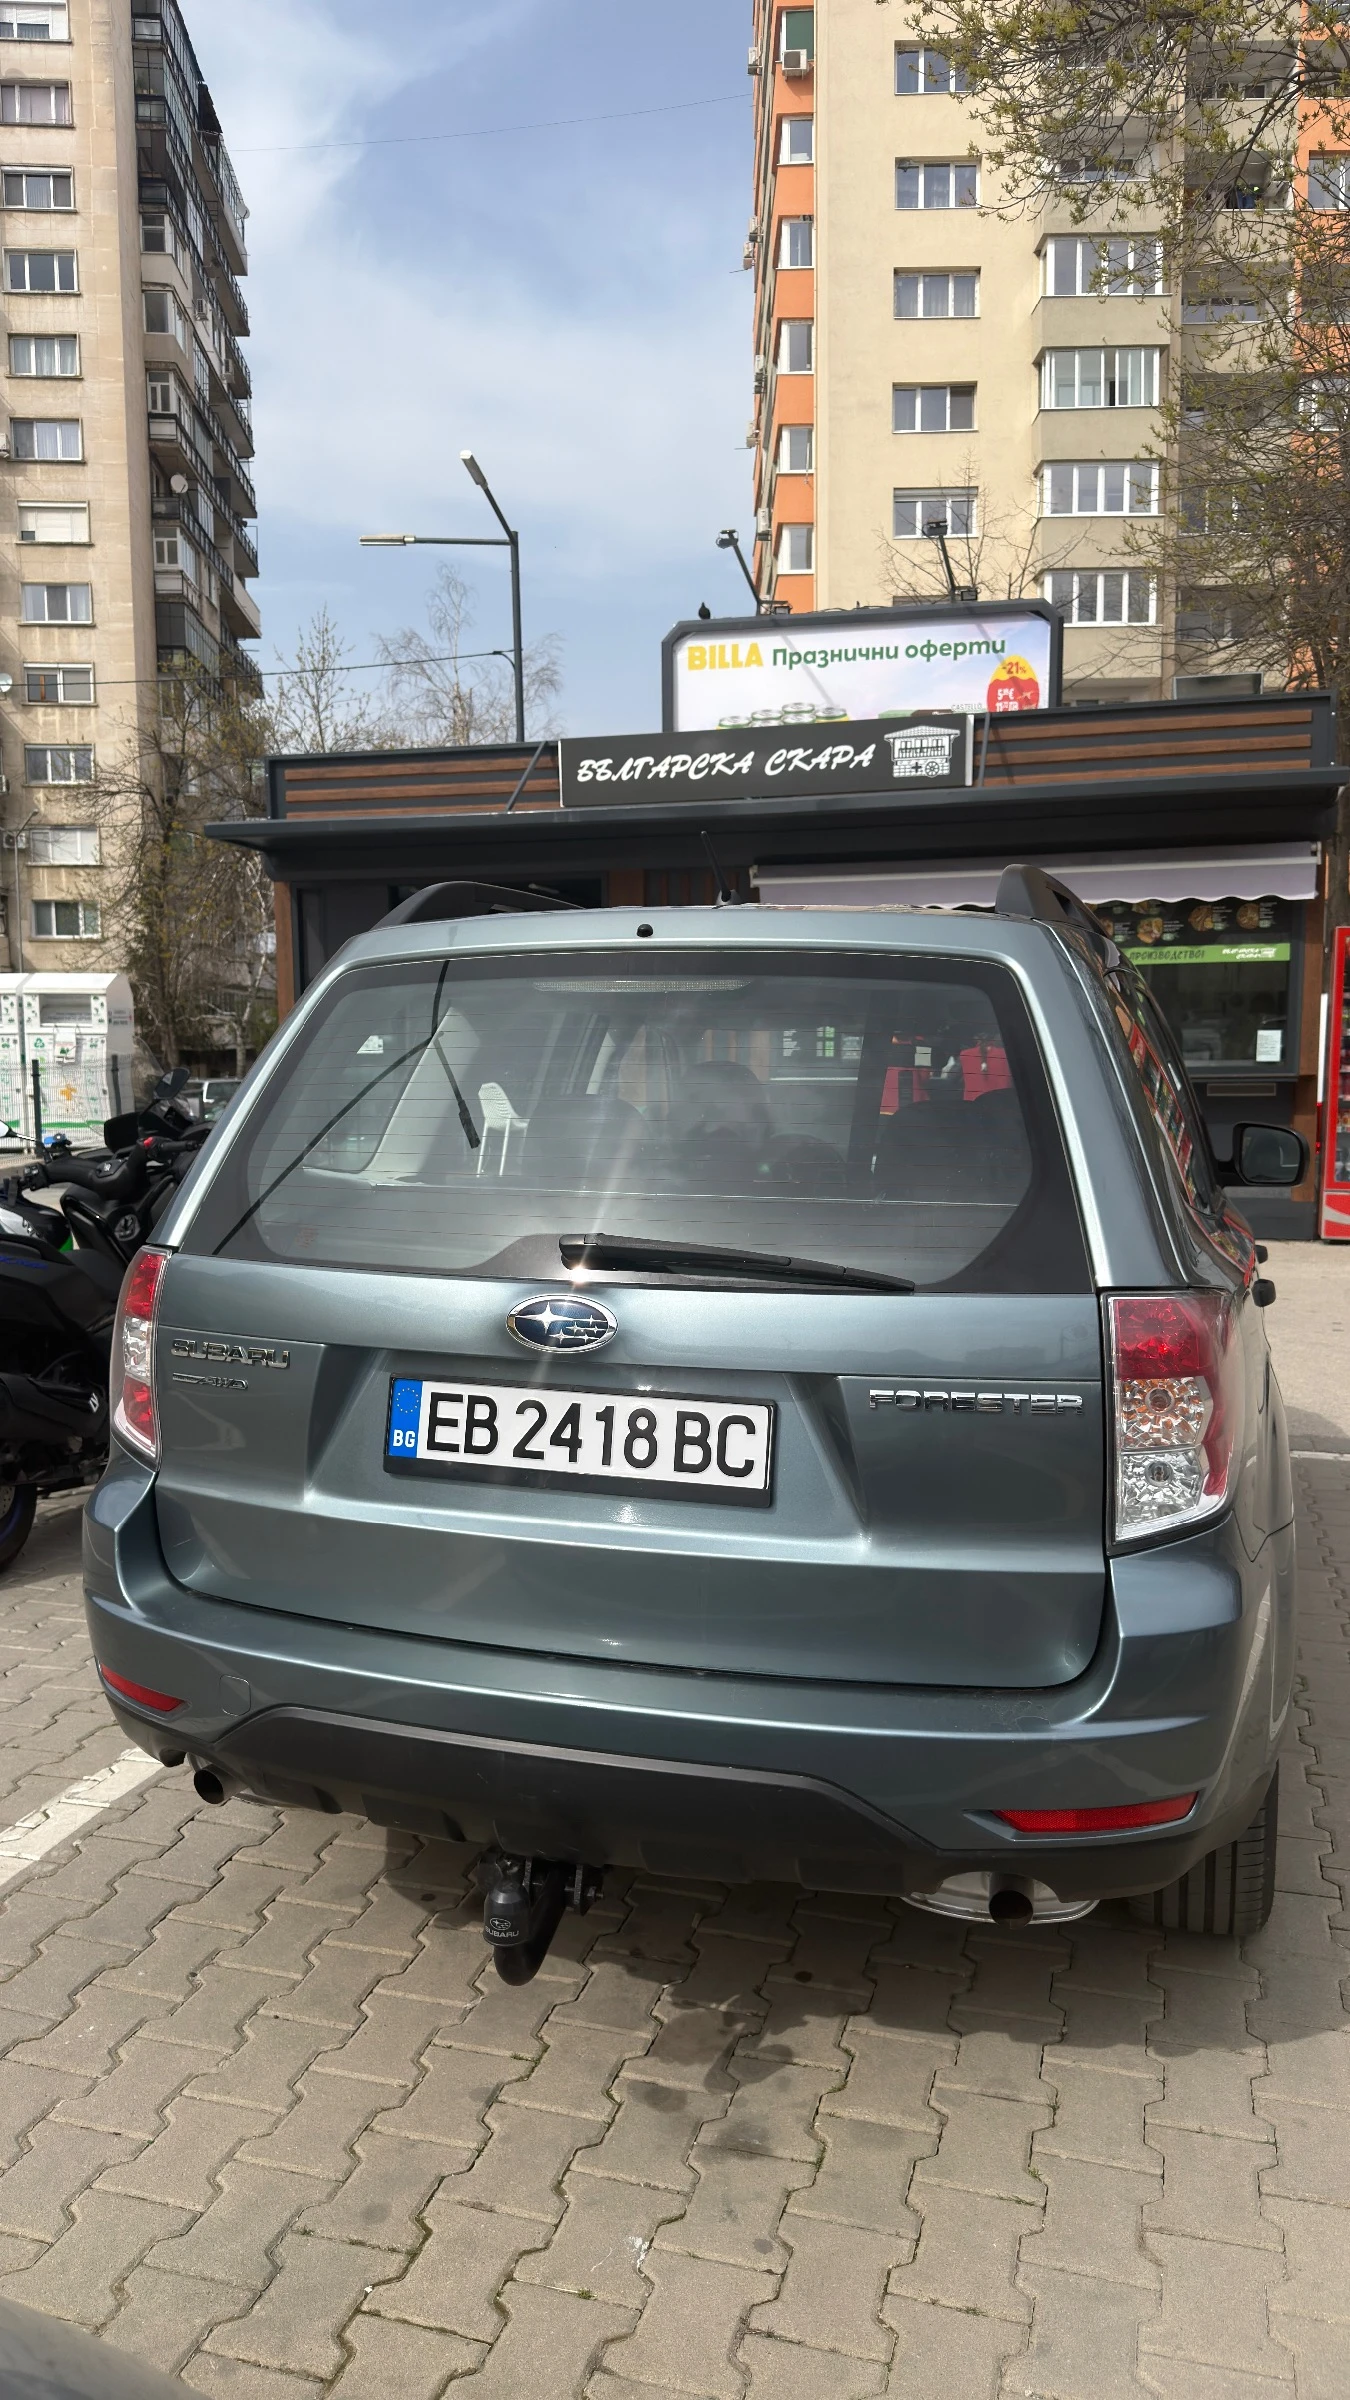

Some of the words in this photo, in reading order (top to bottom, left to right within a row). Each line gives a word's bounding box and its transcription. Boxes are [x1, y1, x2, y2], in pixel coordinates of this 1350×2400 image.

[687, 642, 763, 671] BILLA
[772, 645, 899, 669] Празнични
[905, 639, 1006, 662] оферти
[1002, 661, 1027, 675] -21%
[577, 749, 755, 783] БЪЛГАРСКА
[764, 744, 876, 776] СКАРА
[170, 1338, 290, 1369] SUBARU
[199, 1375, 249, 1390] AWD
[869, 1389, 1084, 1415] FORESTER
[392, 1429, 416, 1449] BG
[426, 1391, 500, 1455] EB
[512, 1399, 659, 1470] 2418
[673, 1410, 757, 1478] BC
[485, 1925, 520, 1937] SUBARU
